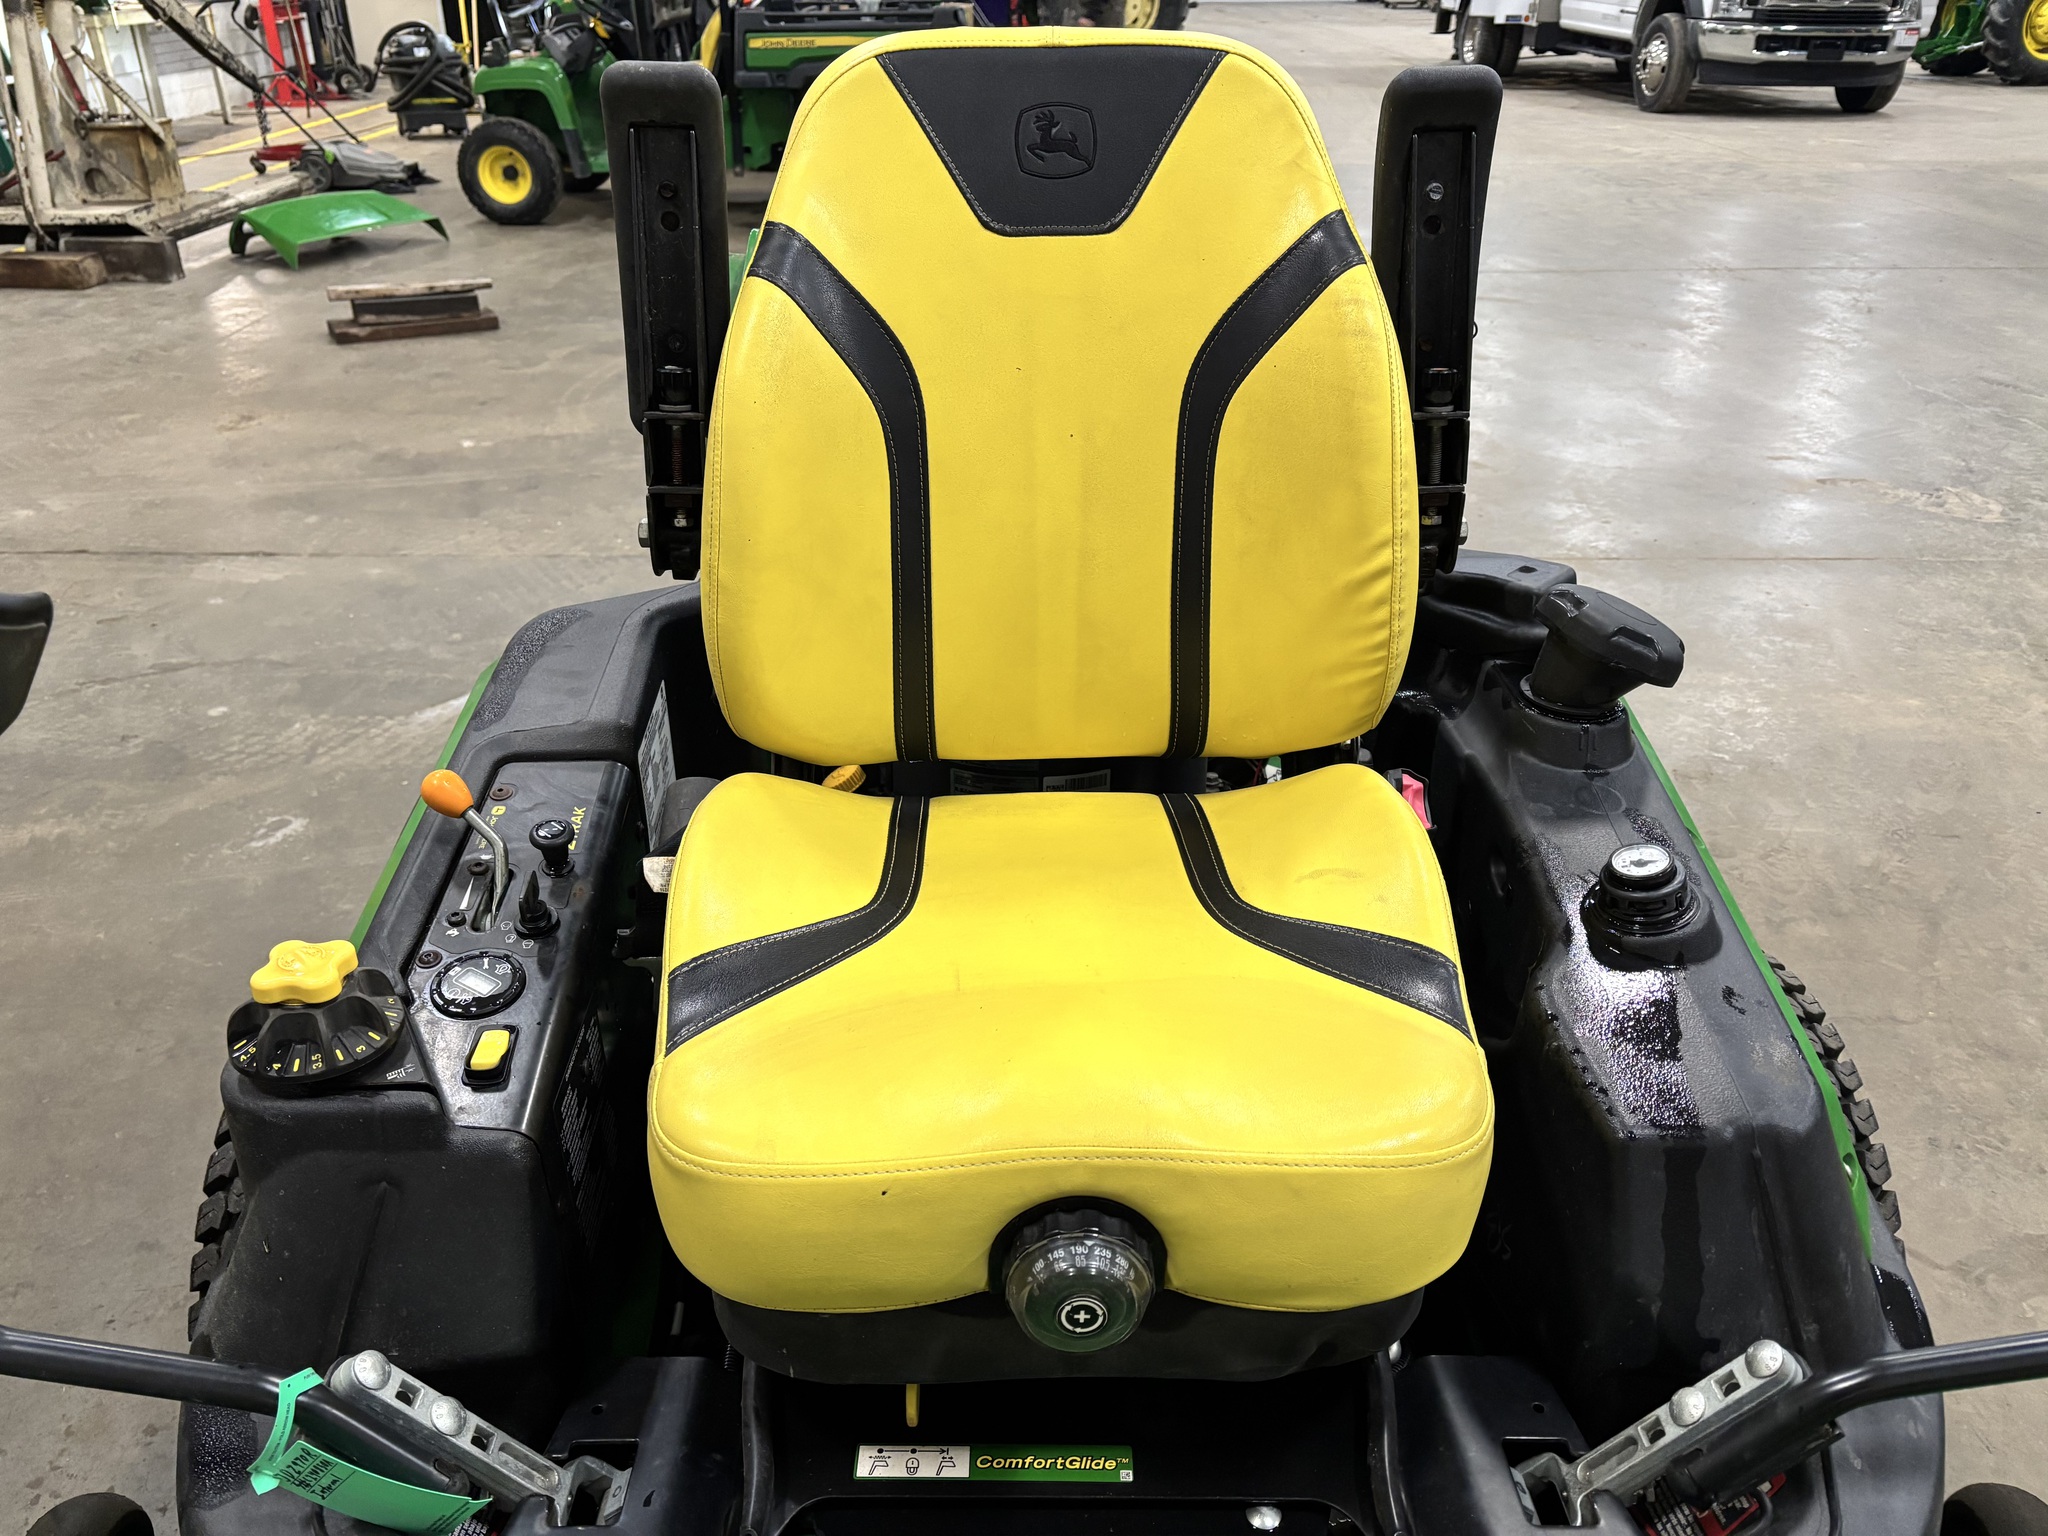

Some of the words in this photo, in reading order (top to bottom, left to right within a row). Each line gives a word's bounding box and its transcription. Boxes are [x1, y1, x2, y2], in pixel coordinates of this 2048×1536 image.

[355, 1045, 366, 1054] 3
[311, 1053, 323, 1070] 3.5
[1047, 1249, 1065, 1261] 145
[1070, 1245, 1089, 1255] 190
[1094, 1246, 1112, 1259] 235
[1075, 1255, 1087, 1268] 85
